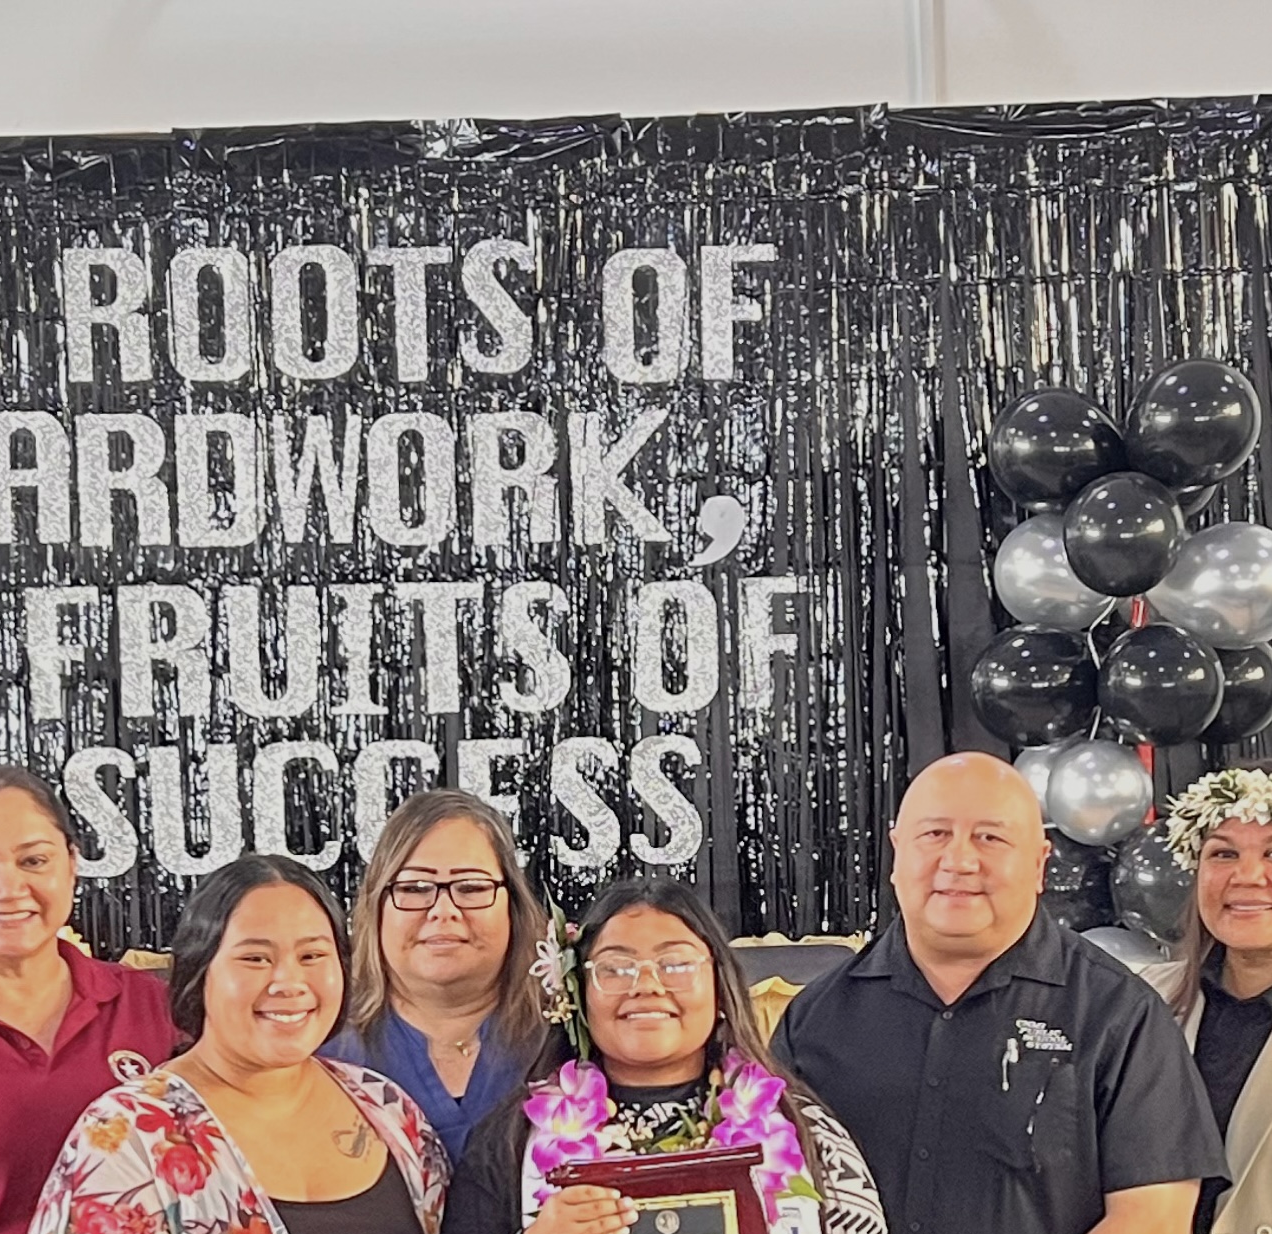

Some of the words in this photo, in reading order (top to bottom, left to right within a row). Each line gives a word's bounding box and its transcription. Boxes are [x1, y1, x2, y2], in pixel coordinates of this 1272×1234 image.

[61, 239, 536, 384] ROOTS
[600, 243, 777, 383] OF
[25, 580, 573, 720] FRUITS
[630, 578, 810, 712] OF
[62, 734, 703, 877] SUCCESS
